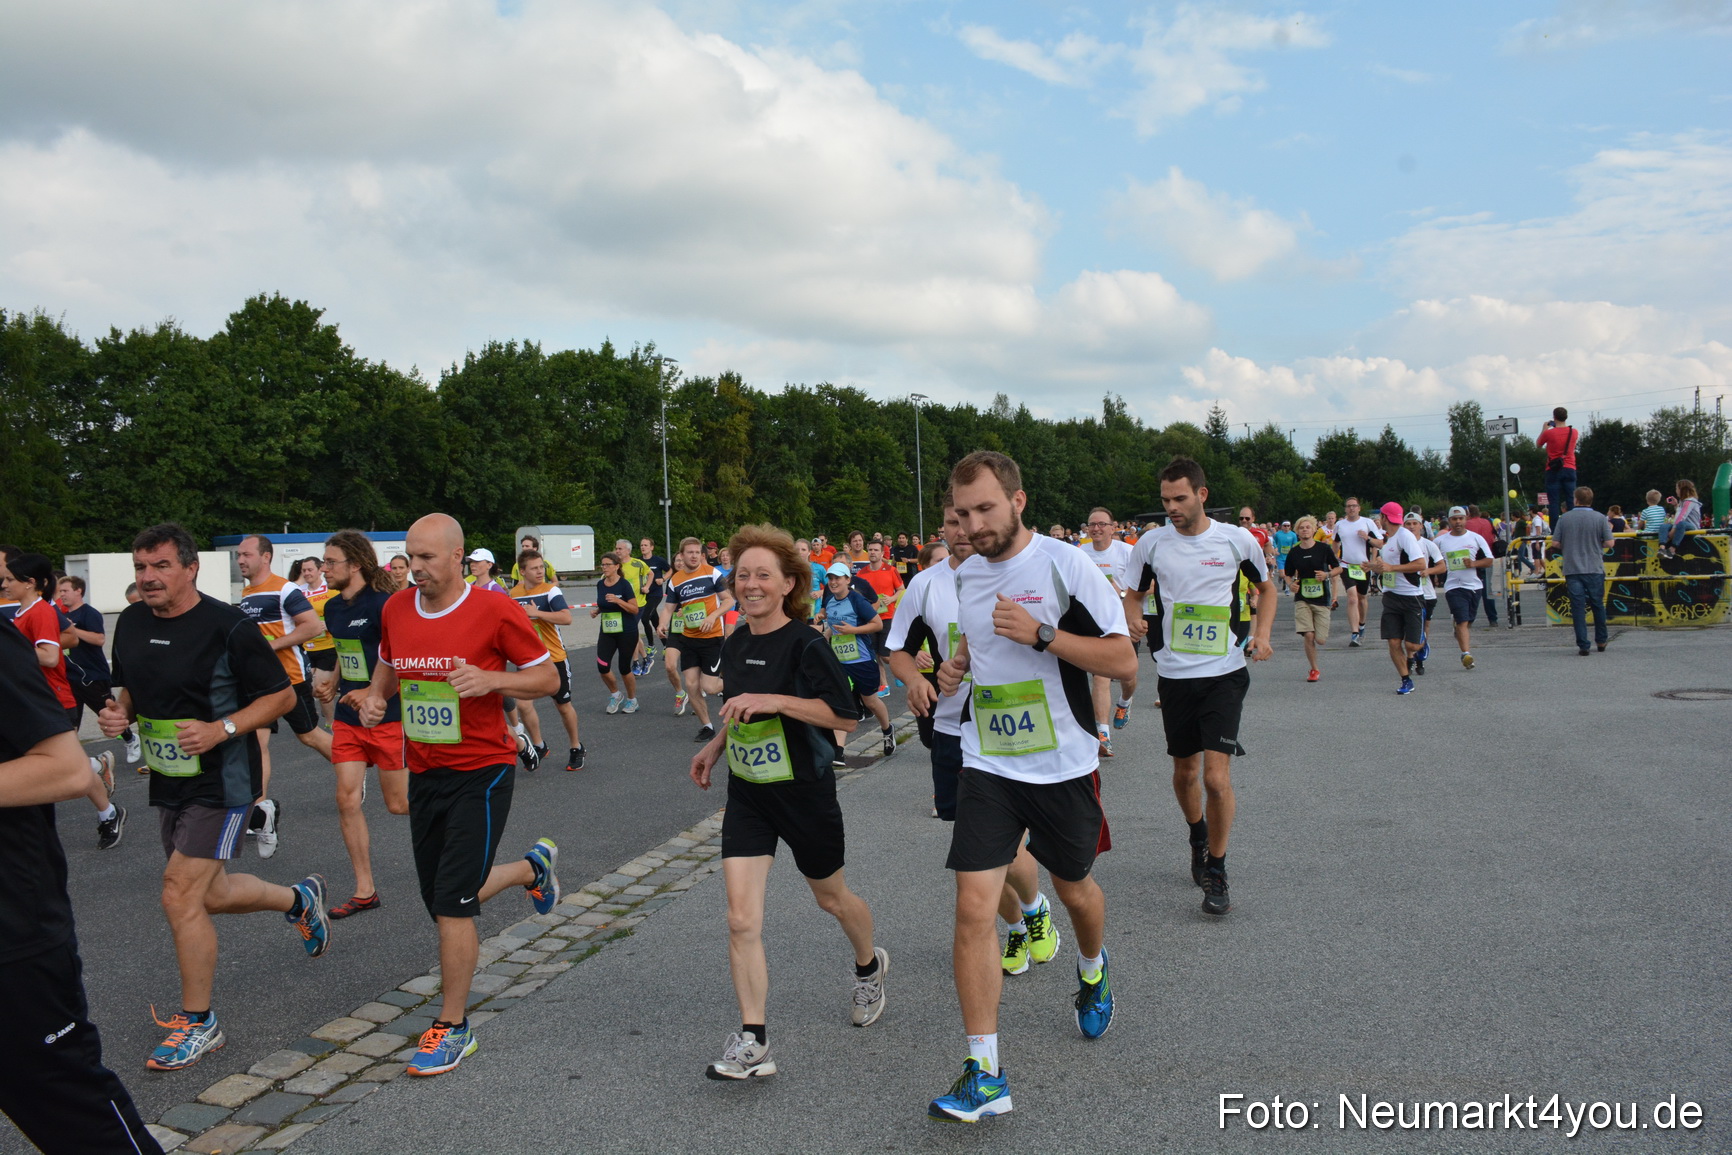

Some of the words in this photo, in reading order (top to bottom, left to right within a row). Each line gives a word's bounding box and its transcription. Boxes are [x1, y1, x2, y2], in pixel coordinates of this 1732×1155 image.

[1304, 584, 1321, 592] 1224
[685, 611, 705, 622] 1622
[1182, 623, 1217, 641] 415
[834, 643, 855, 655] 1328
[341, 656, 359, 669] 779
[406, 704, 453, 726] 1399
[989, 710, 1035, 737] 404
[730, 742, 781, 767] 1228
[57, 1022, 76, 1038] JAKO
